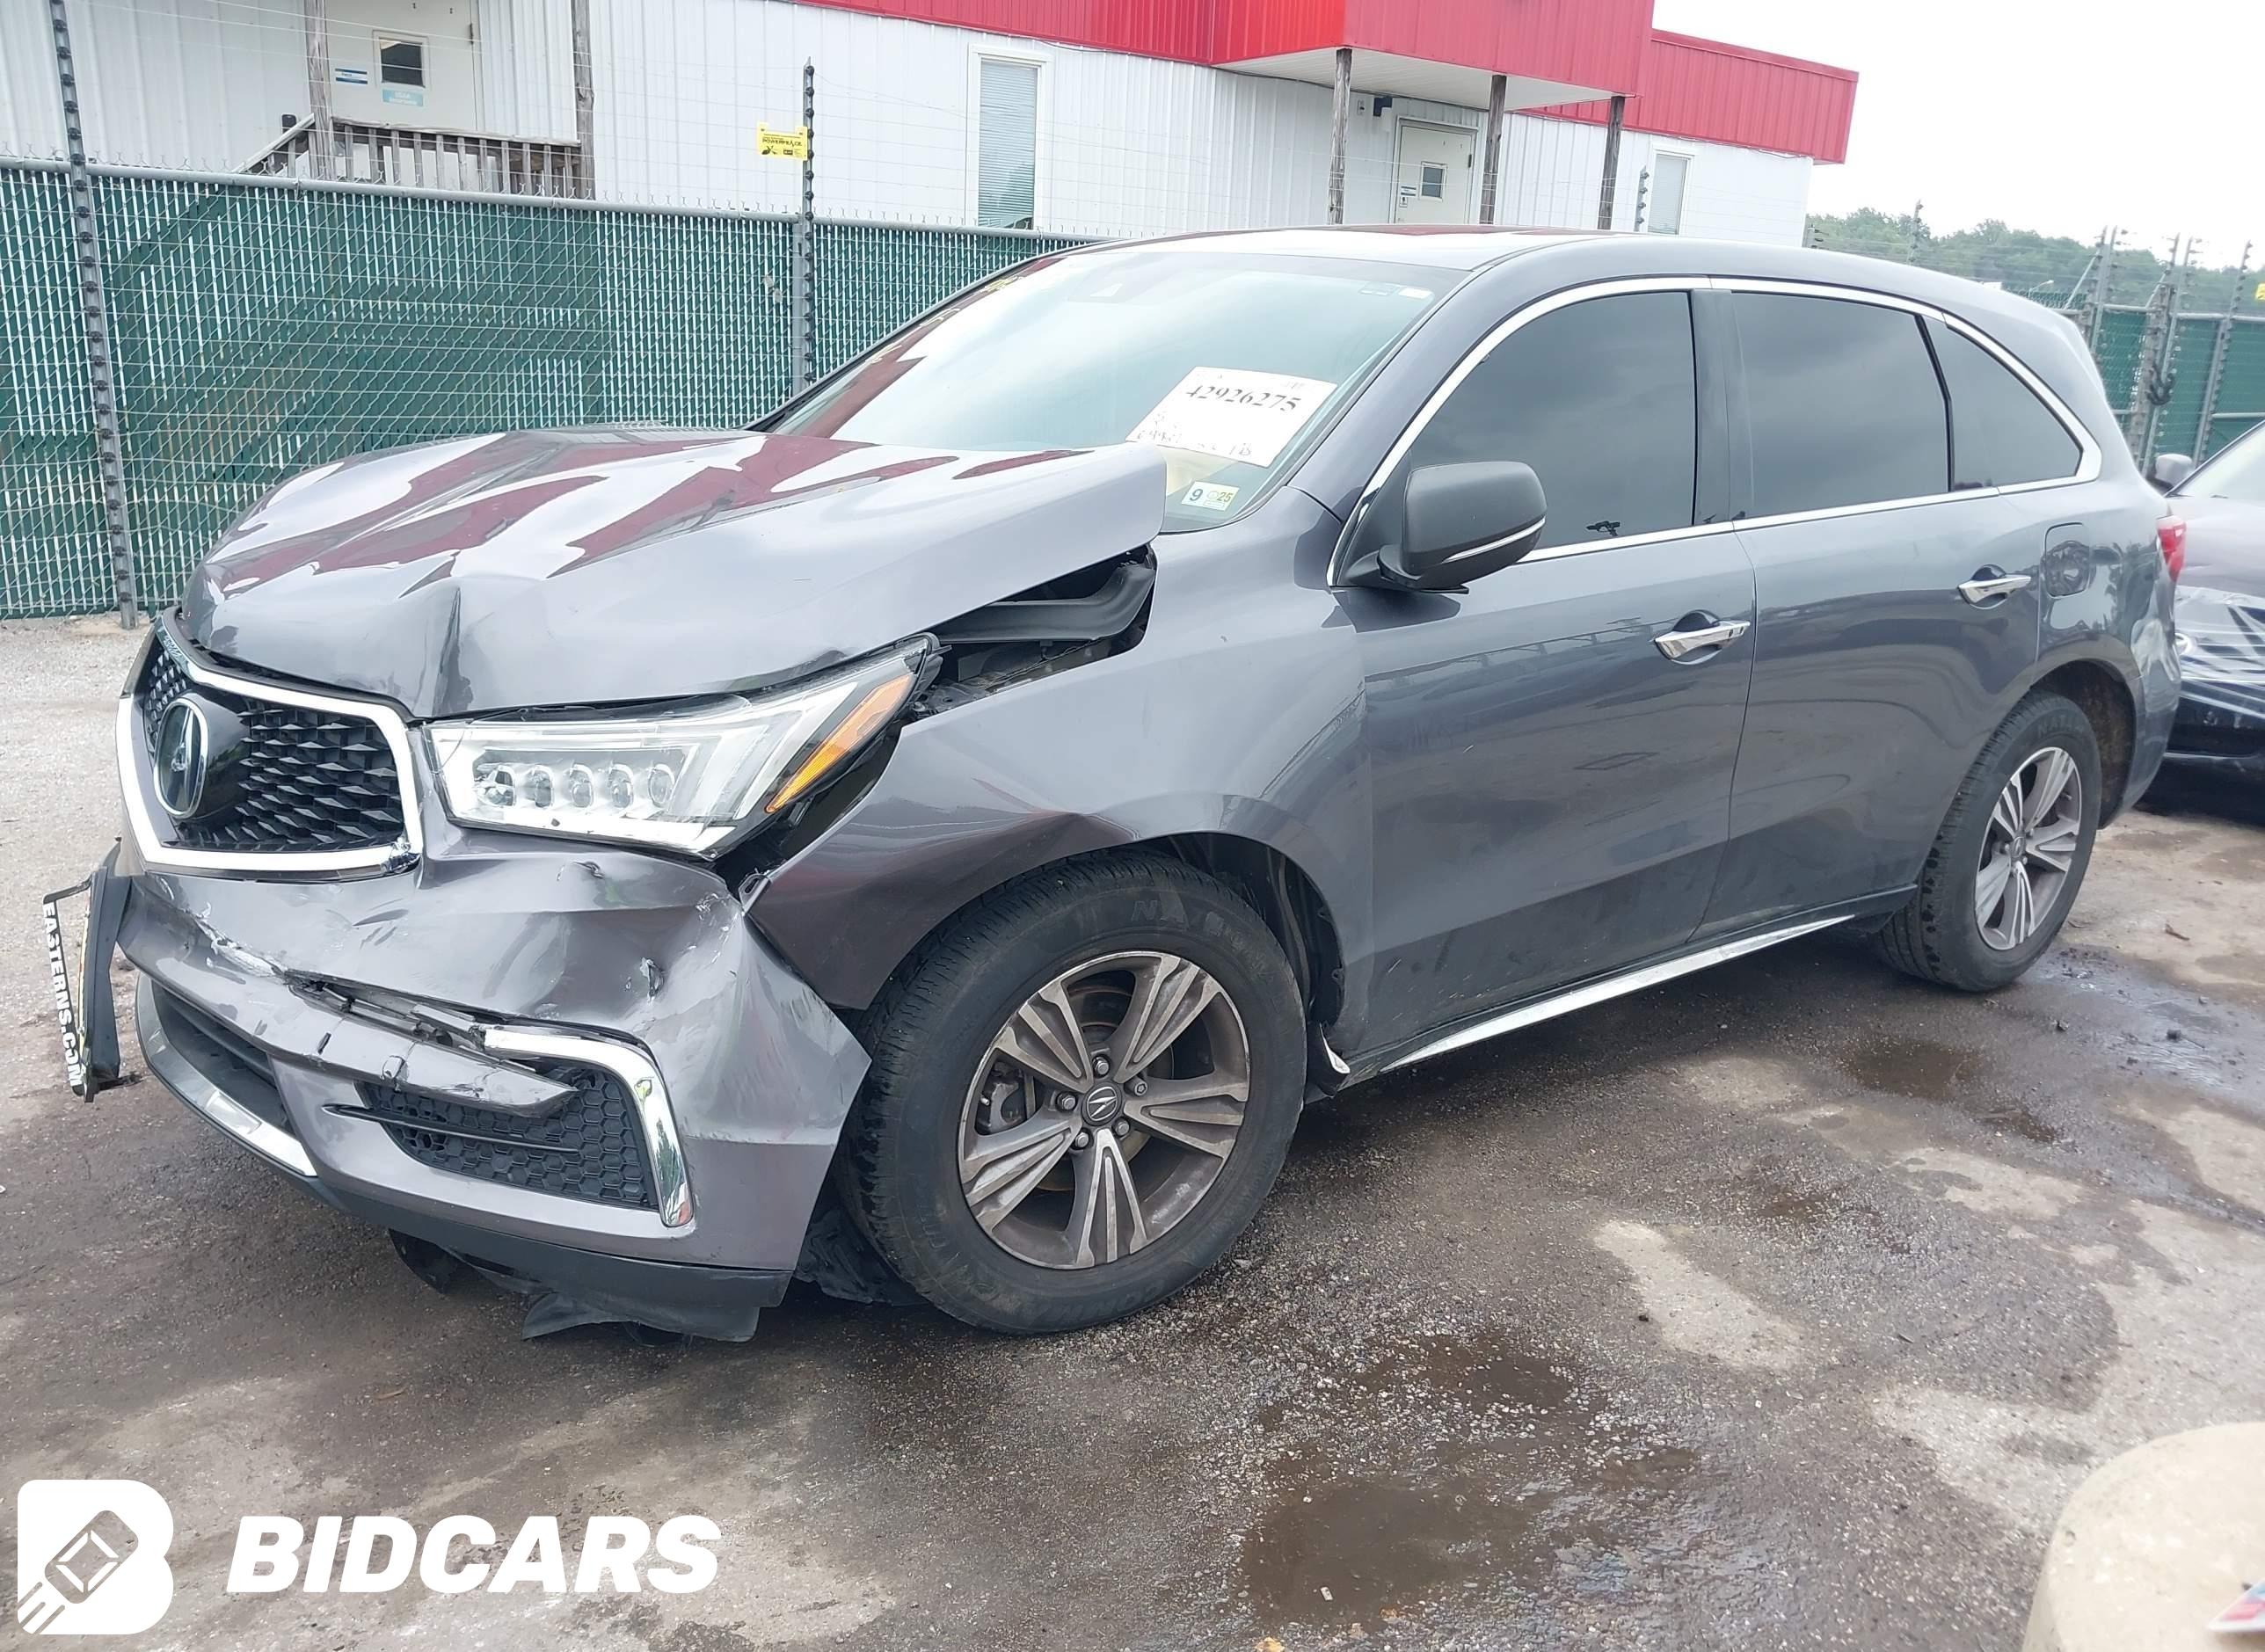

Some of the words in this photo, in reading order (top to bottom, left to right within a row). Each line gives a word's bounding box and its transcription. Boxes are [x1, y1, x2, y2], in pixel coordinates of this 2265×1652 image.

[1185, 385, 1301, 411] 42926275
[1189, 488, 1204, 501] 9
[1216, 491, 1234, 502] 25
[44, 902, 84, 1088] EASTERNS.COM
